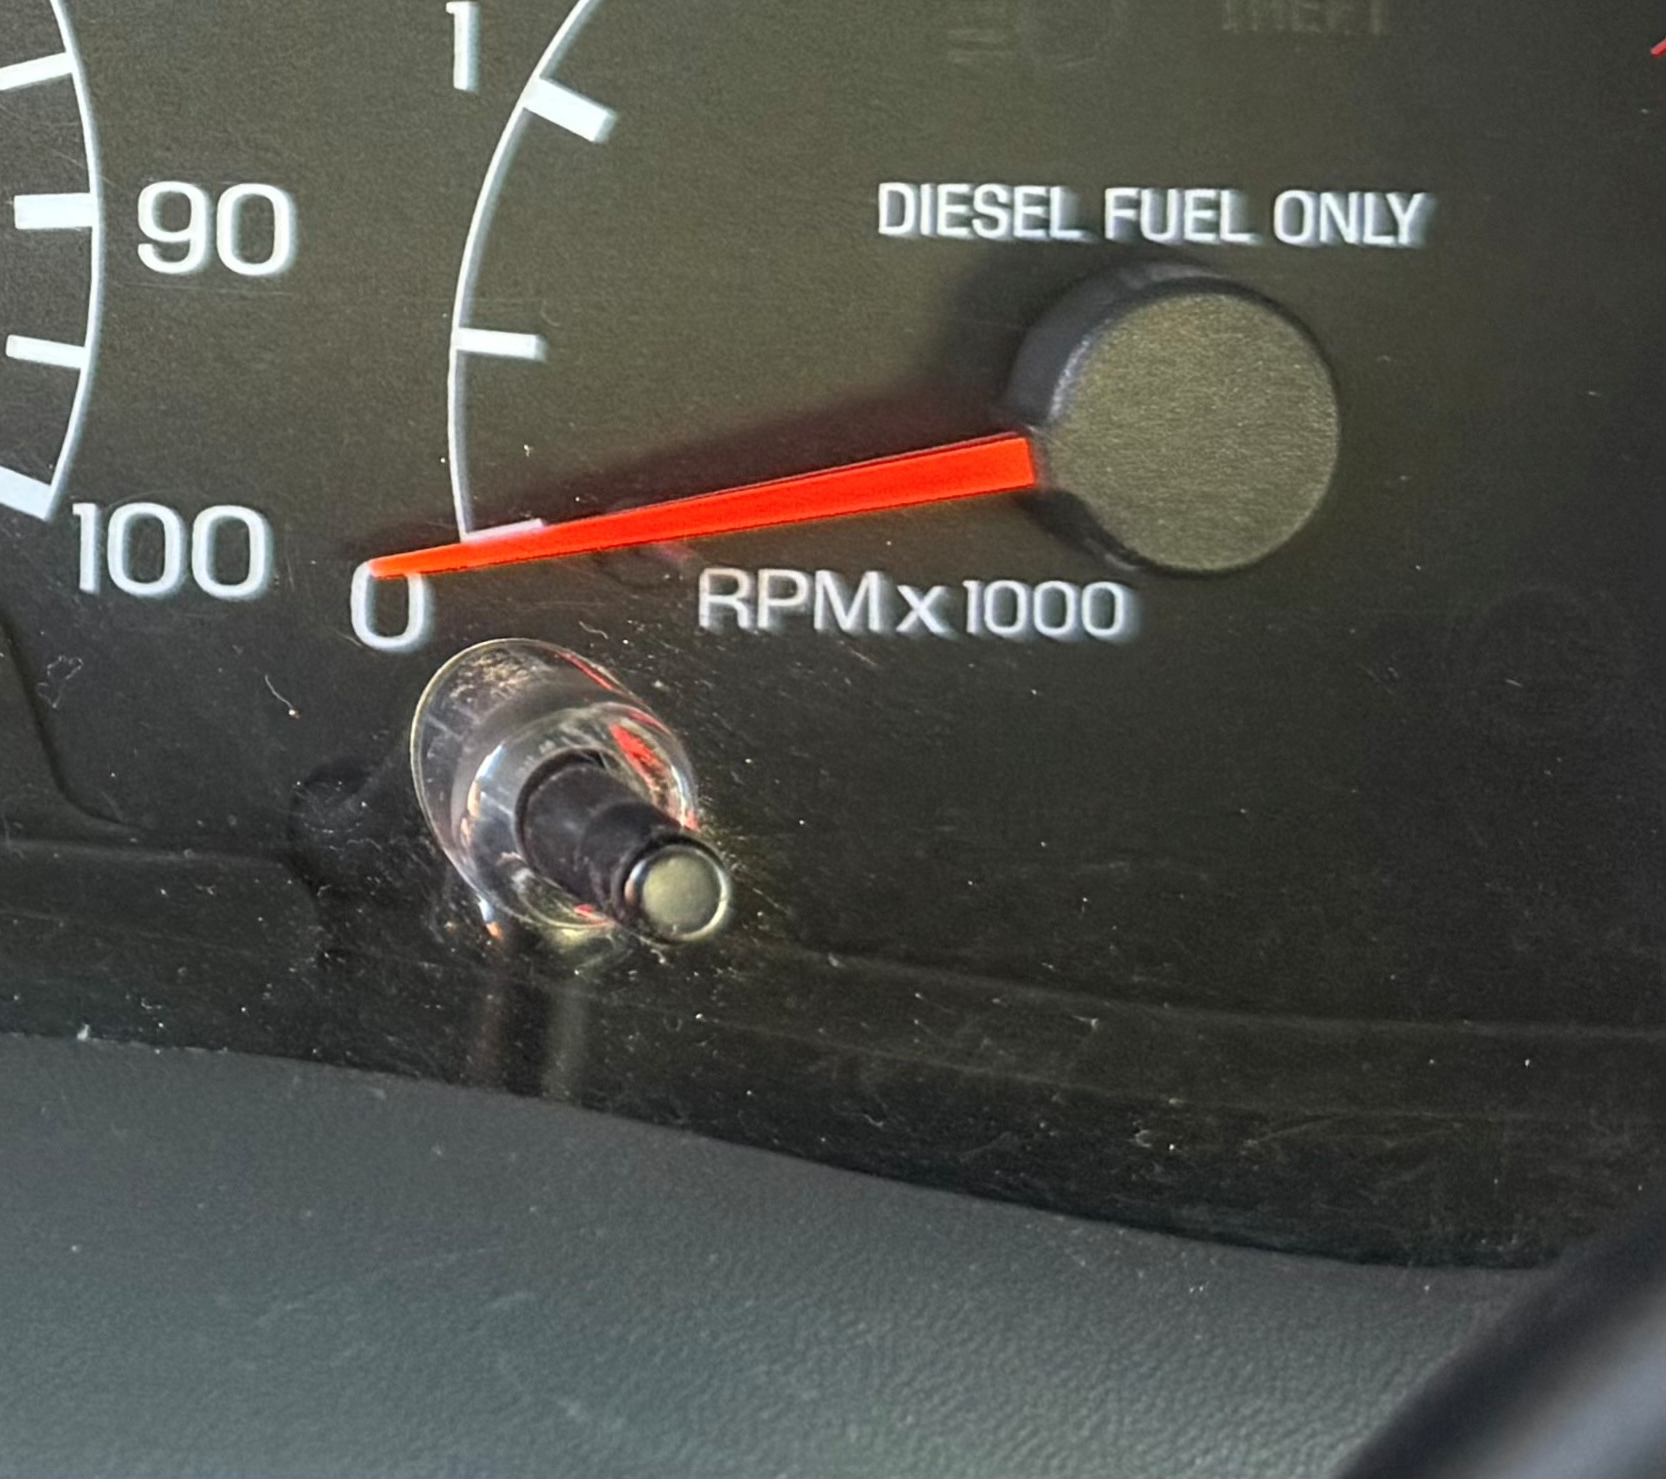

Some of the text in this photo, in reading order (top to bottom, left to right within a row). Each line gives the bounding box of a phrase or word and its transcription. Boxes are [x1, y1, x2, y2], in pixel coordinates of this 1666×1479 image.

[444, 0, 476, 92] 1
[136, 180, 295, 278] 90
[877, 181, 1425, 247] DIESEL FUEL ONLY
[71, 501, 269, 600] 100
[349, 559, 431, 652] 0
